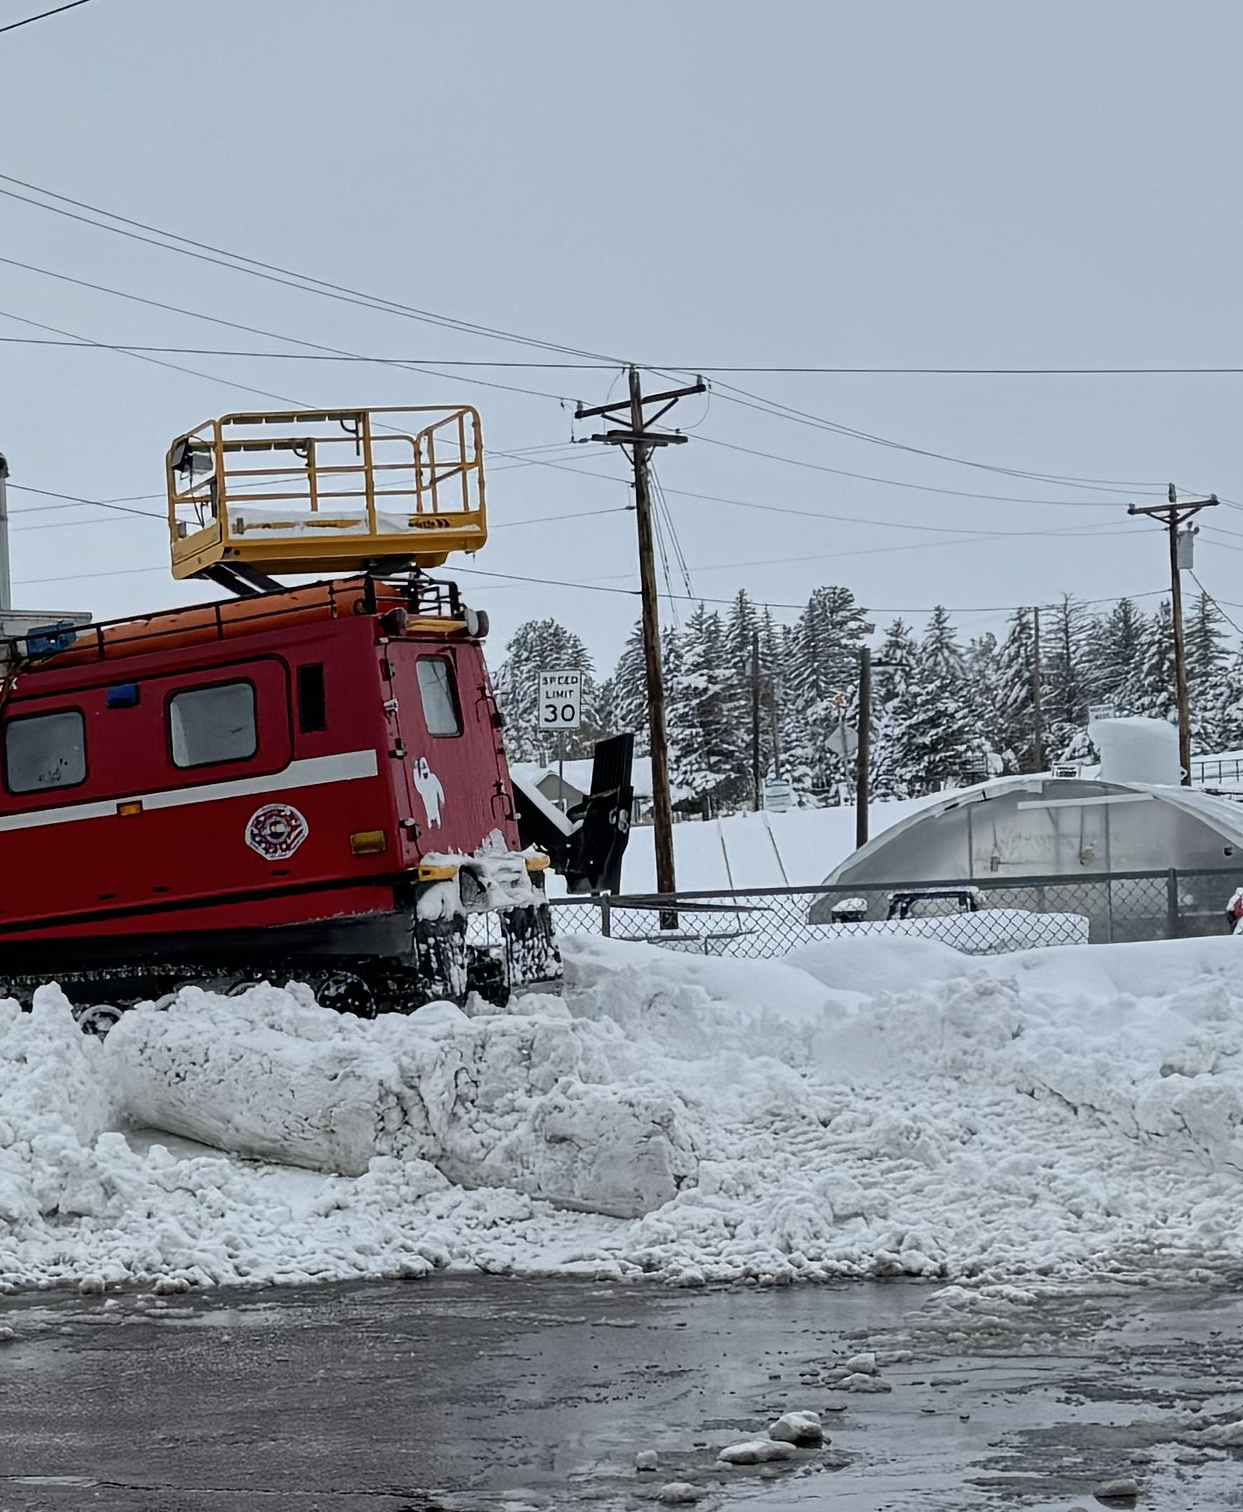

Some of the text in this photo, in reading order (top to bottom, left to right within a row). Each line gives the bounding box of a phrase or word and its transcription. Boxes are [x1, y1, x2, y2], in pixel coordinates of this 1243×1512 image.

[542, 675, 578, 685] SPEED
[545, 689, 574, 699] LIMIT
[543, 704, 575, 722] 30
